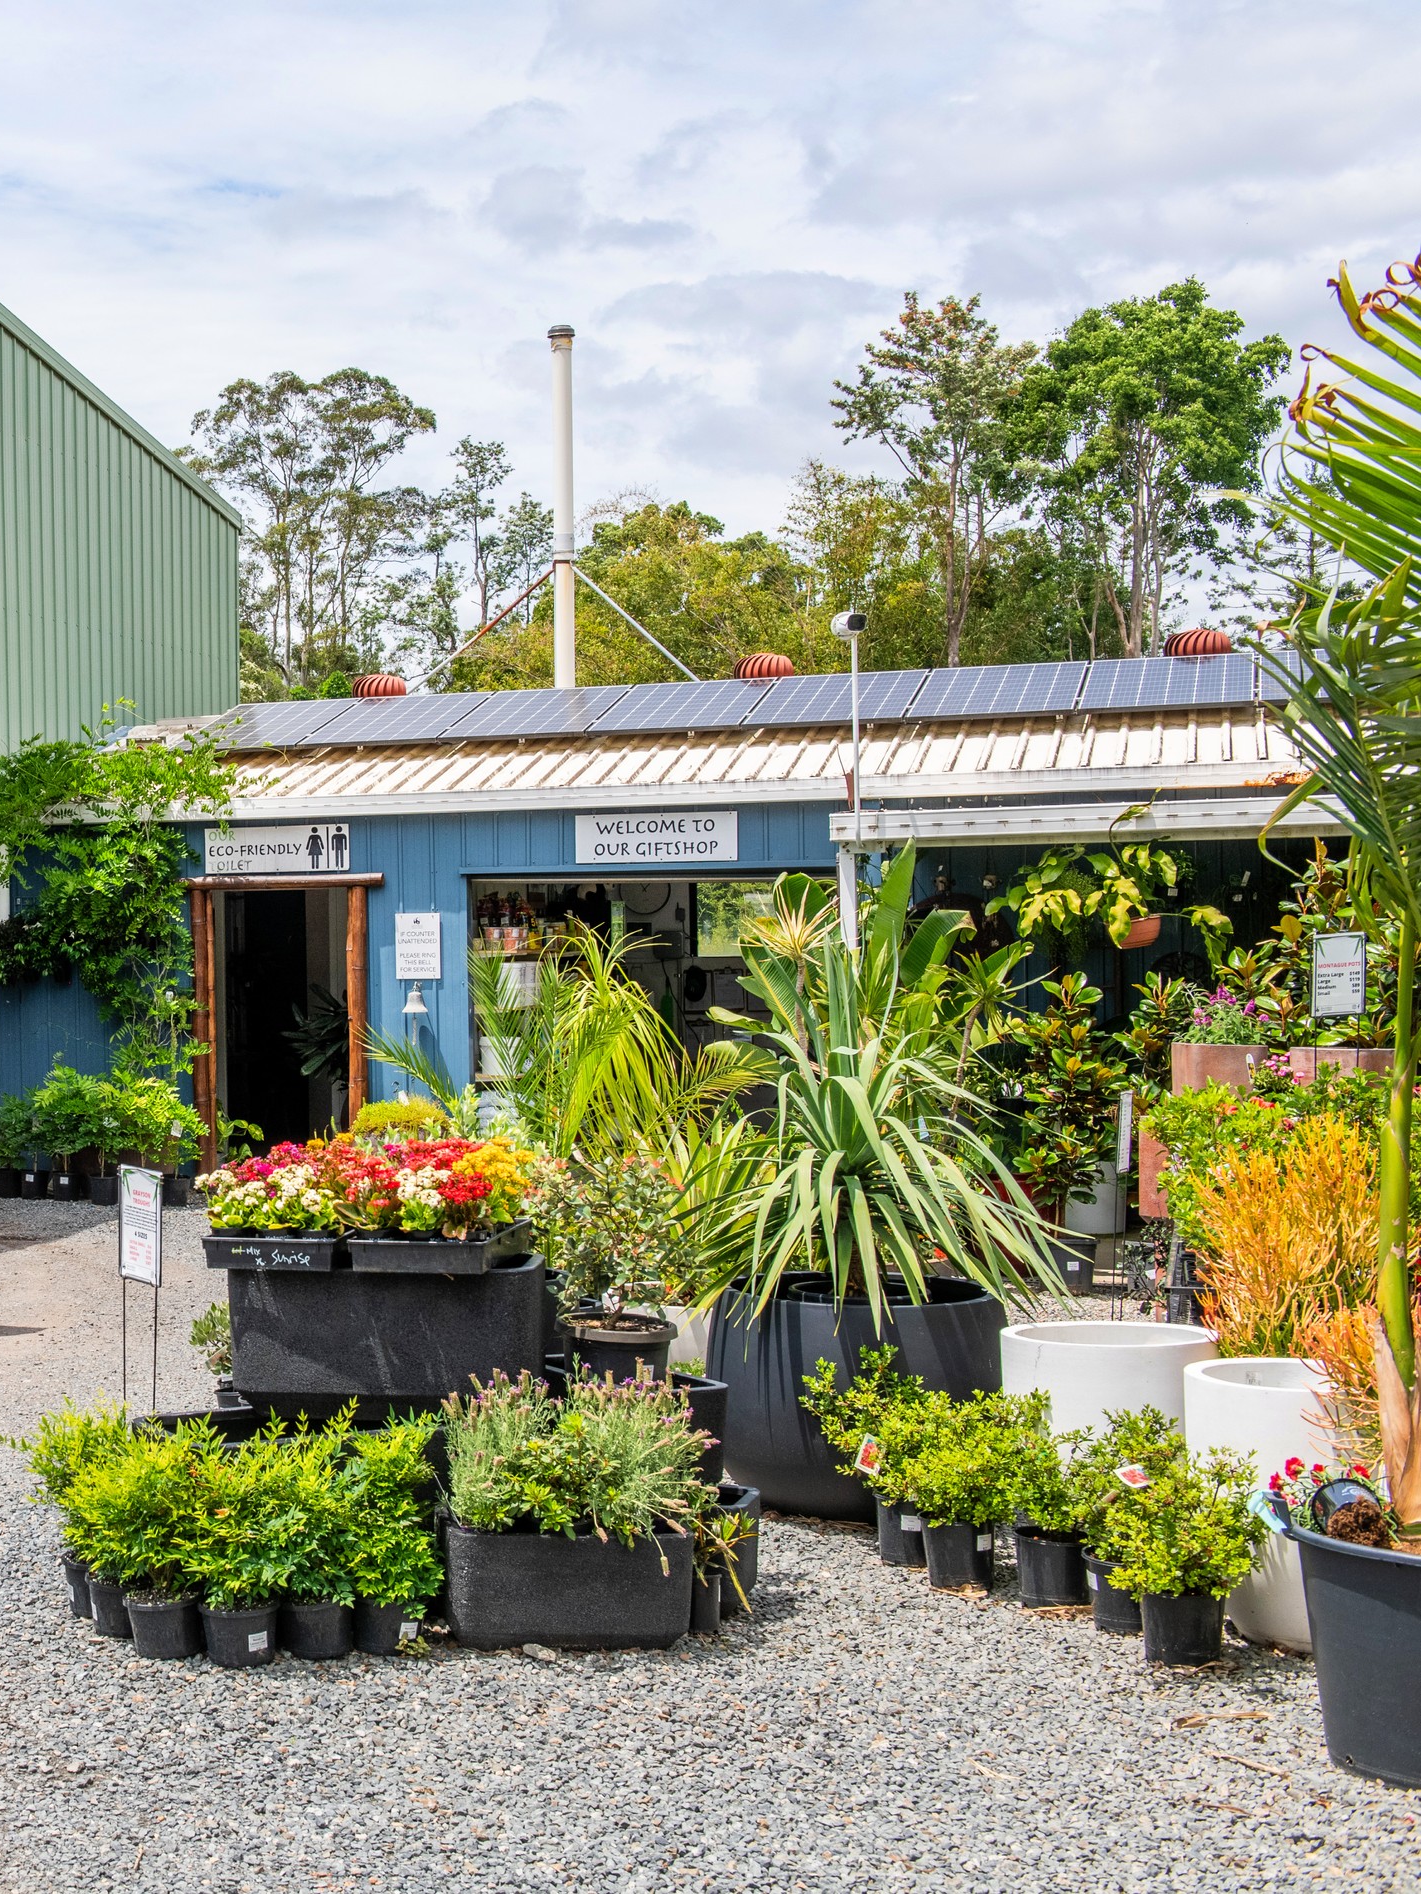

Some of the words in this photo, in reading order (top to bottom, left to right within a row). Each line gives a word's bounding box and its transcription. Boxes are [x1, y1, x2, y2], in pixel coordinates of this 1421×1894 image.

[595, 819, 686, 835] WELCOME
[692, 818, 715, 833] TO
[208, 831, 236, 842] OUR
[208, 843, 302, 857] ECO-FRIENDLY
[594, 842, 630, 856] OUR
[636, 840, 718, 857] GIFTSHOP
[209, 860, 253, 872] TOILET
[271, 1249, 310, 1266] Sunrise
